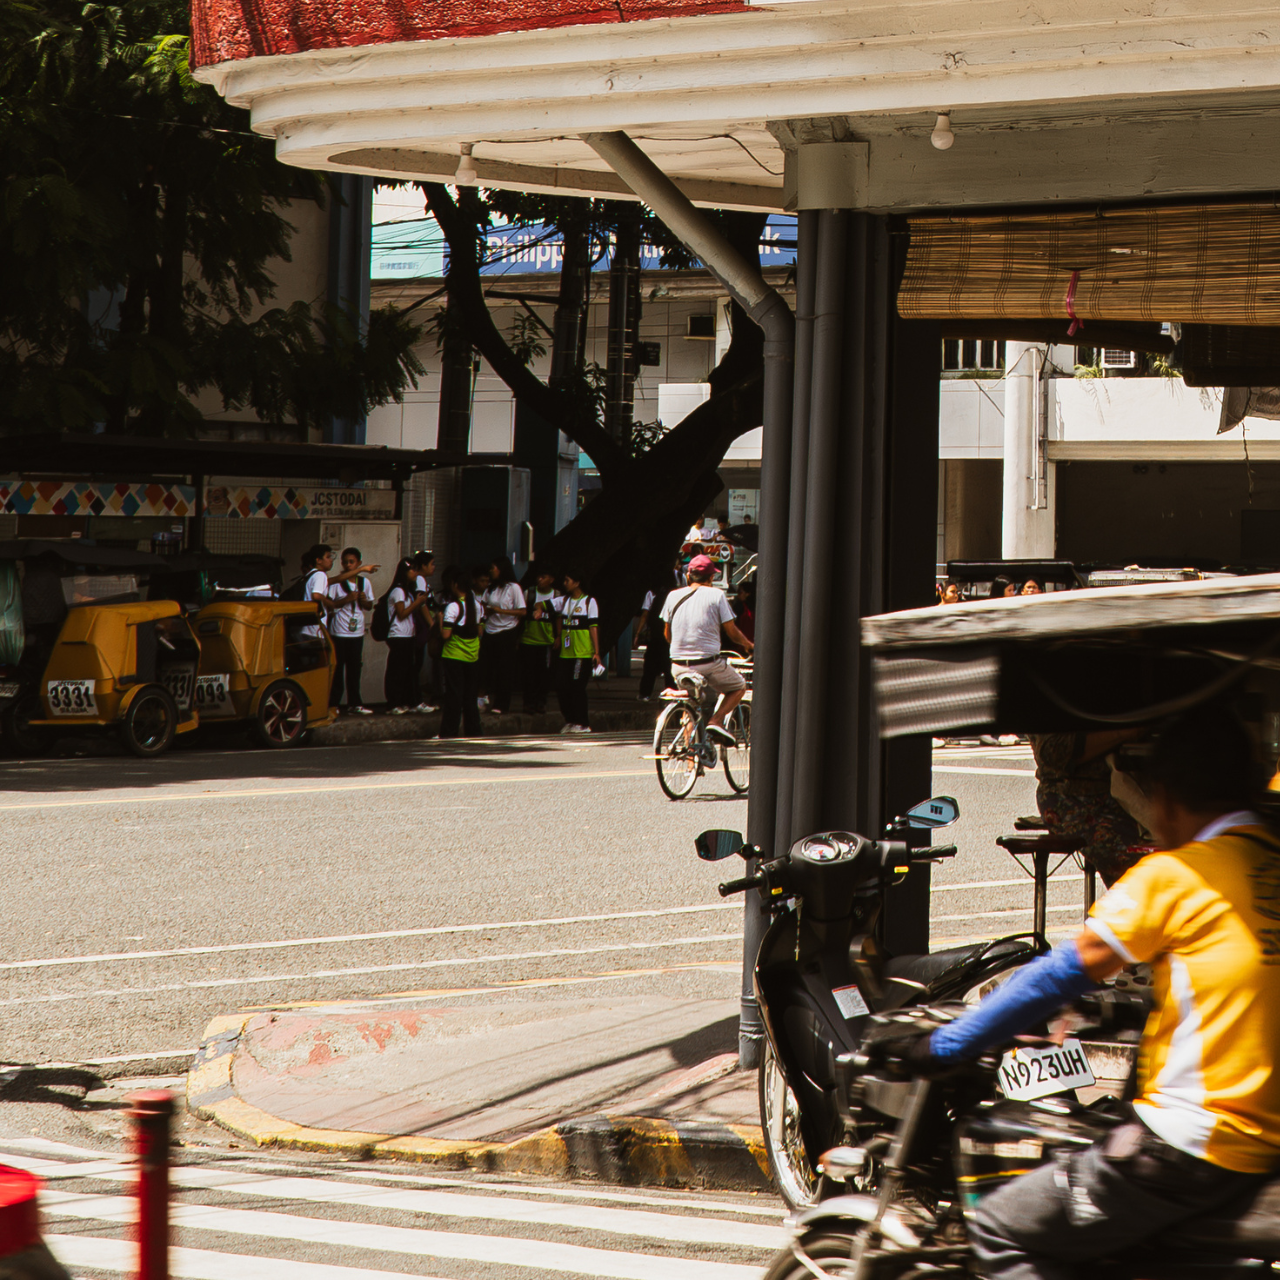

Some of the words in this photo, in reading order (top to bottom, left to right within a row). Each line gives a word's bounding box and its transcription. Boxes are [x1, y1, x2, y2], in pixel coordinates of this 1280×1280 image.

[311, 492, 367, 506] JCSTODAI
[50, 686, 94, 708] 3331
[1002, 1048, 1087, 1091] N923UH
